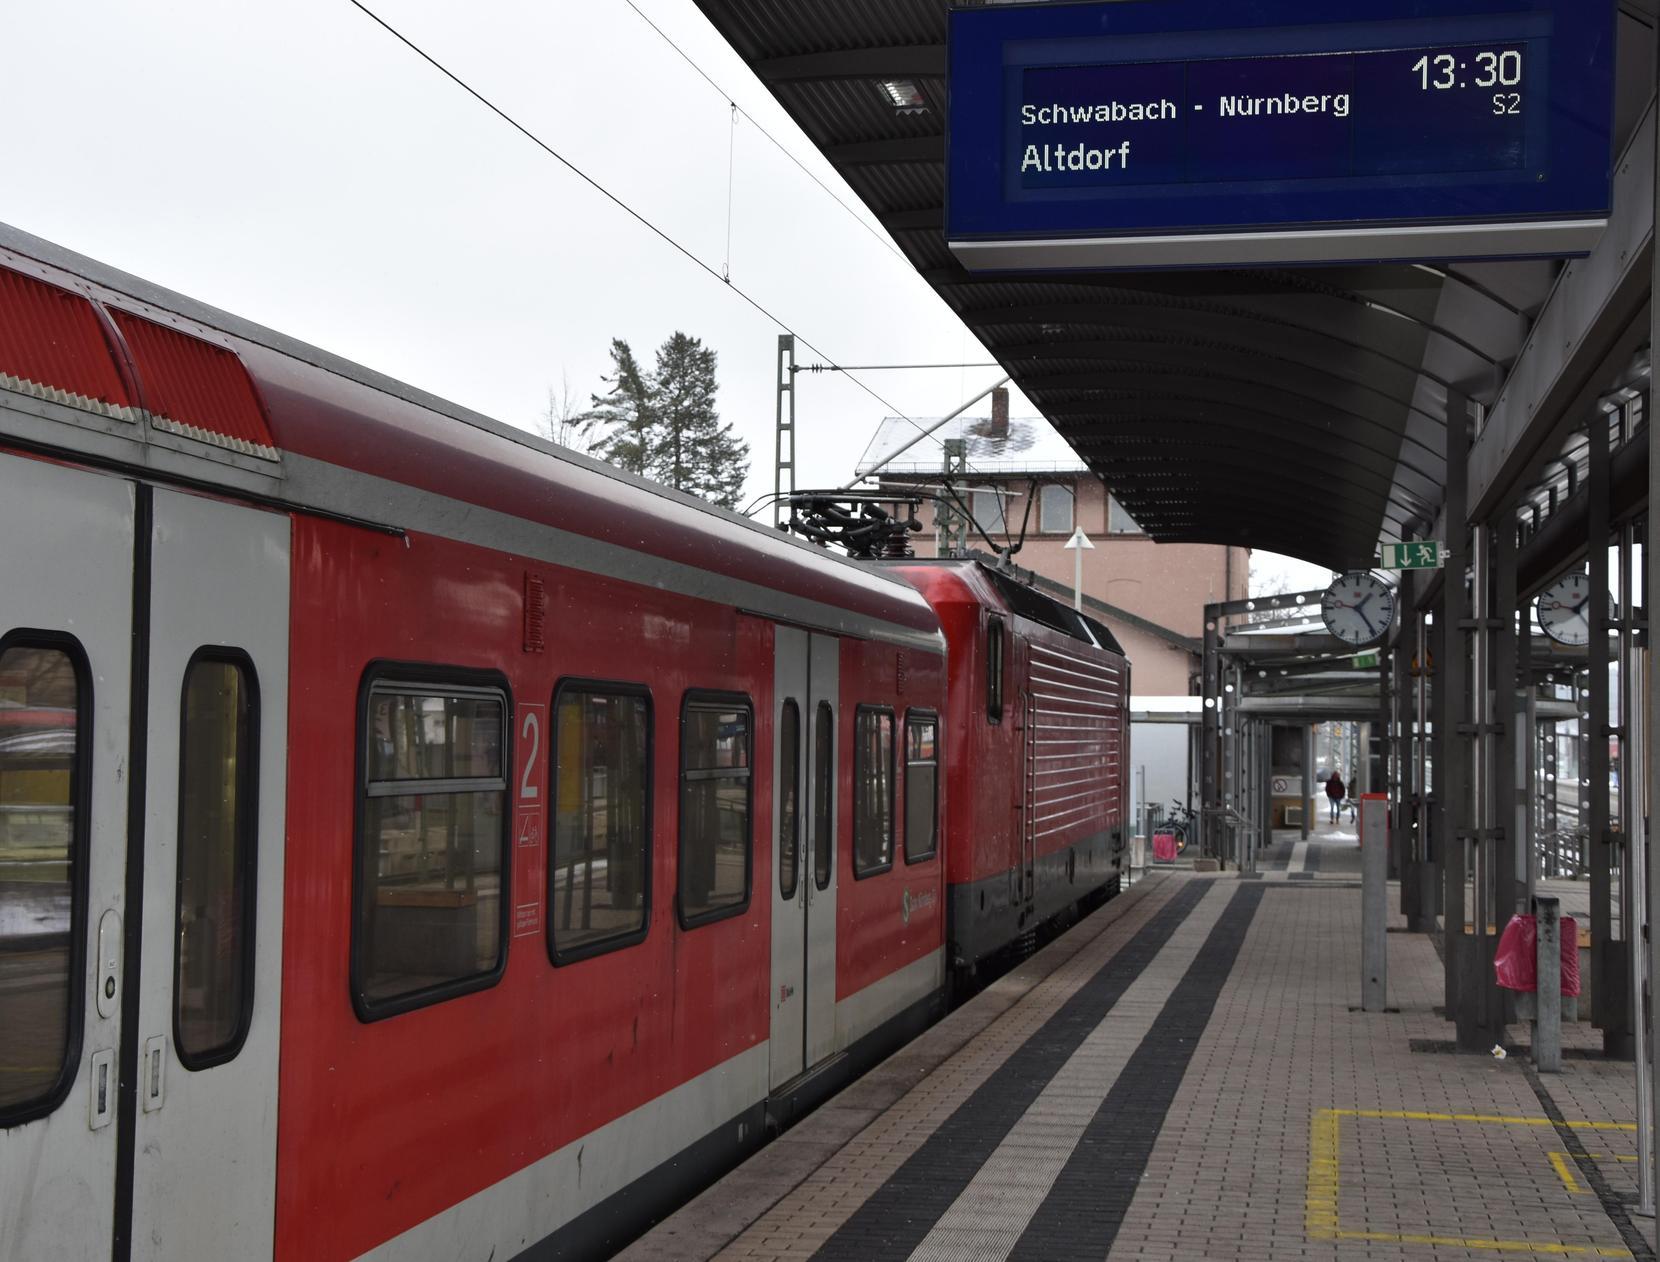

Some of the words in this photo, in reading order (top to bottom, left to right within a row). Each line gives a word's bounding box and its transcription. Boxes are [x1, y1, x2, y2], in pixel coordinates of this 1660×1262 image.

[1412, 51, 1522, 90] 13:30
[1021, 99, 1177, 126] Schwabach
[1220, 93, 1351, 118] Nürnberg
[1492, 93, 1521, 115] S2
[1021, 142, 1131, 172] Altdorf
[520, 713, 538, 798] 2
